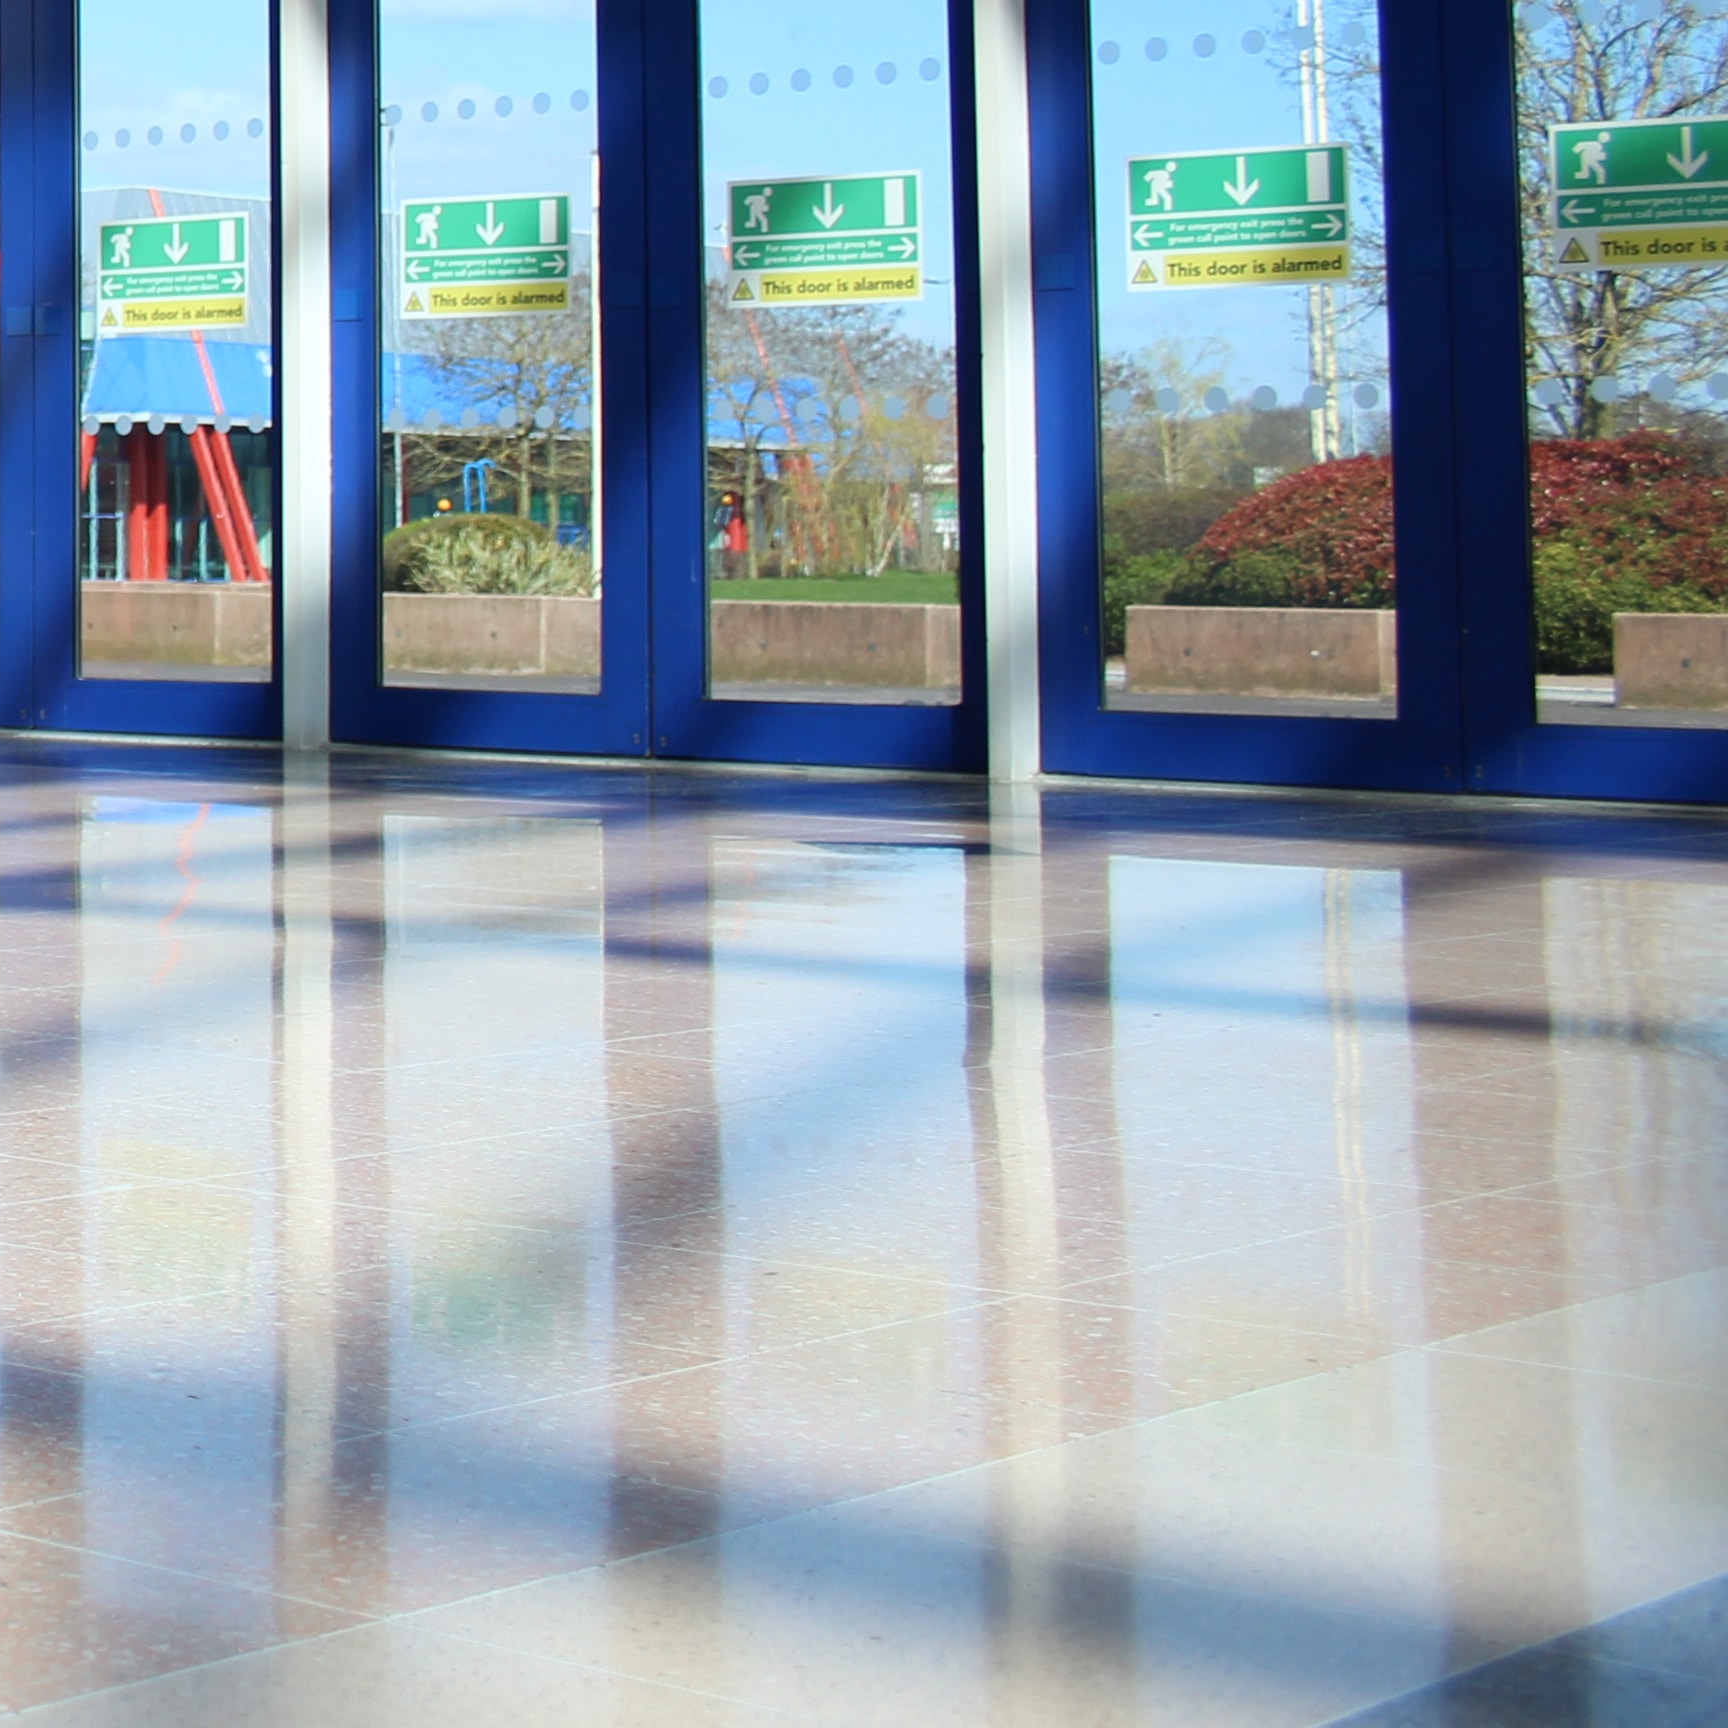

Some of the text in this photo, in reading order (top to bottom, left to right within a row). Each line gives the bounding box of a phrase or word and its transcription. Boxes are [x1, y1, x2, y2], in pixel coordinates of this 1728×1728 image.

[1601, 240, 1640, 256] This
[1646, 238, 1695, 255] door
[1700, 236, 1717, 253] is
[1167, 255, 1342, 278] This door is alarmed
[762, 275, 916, 296] This door is alarmed
[431, 290, 565, 307] This door is alarmed
[125, 305, 243, 323] This door is alarmed
